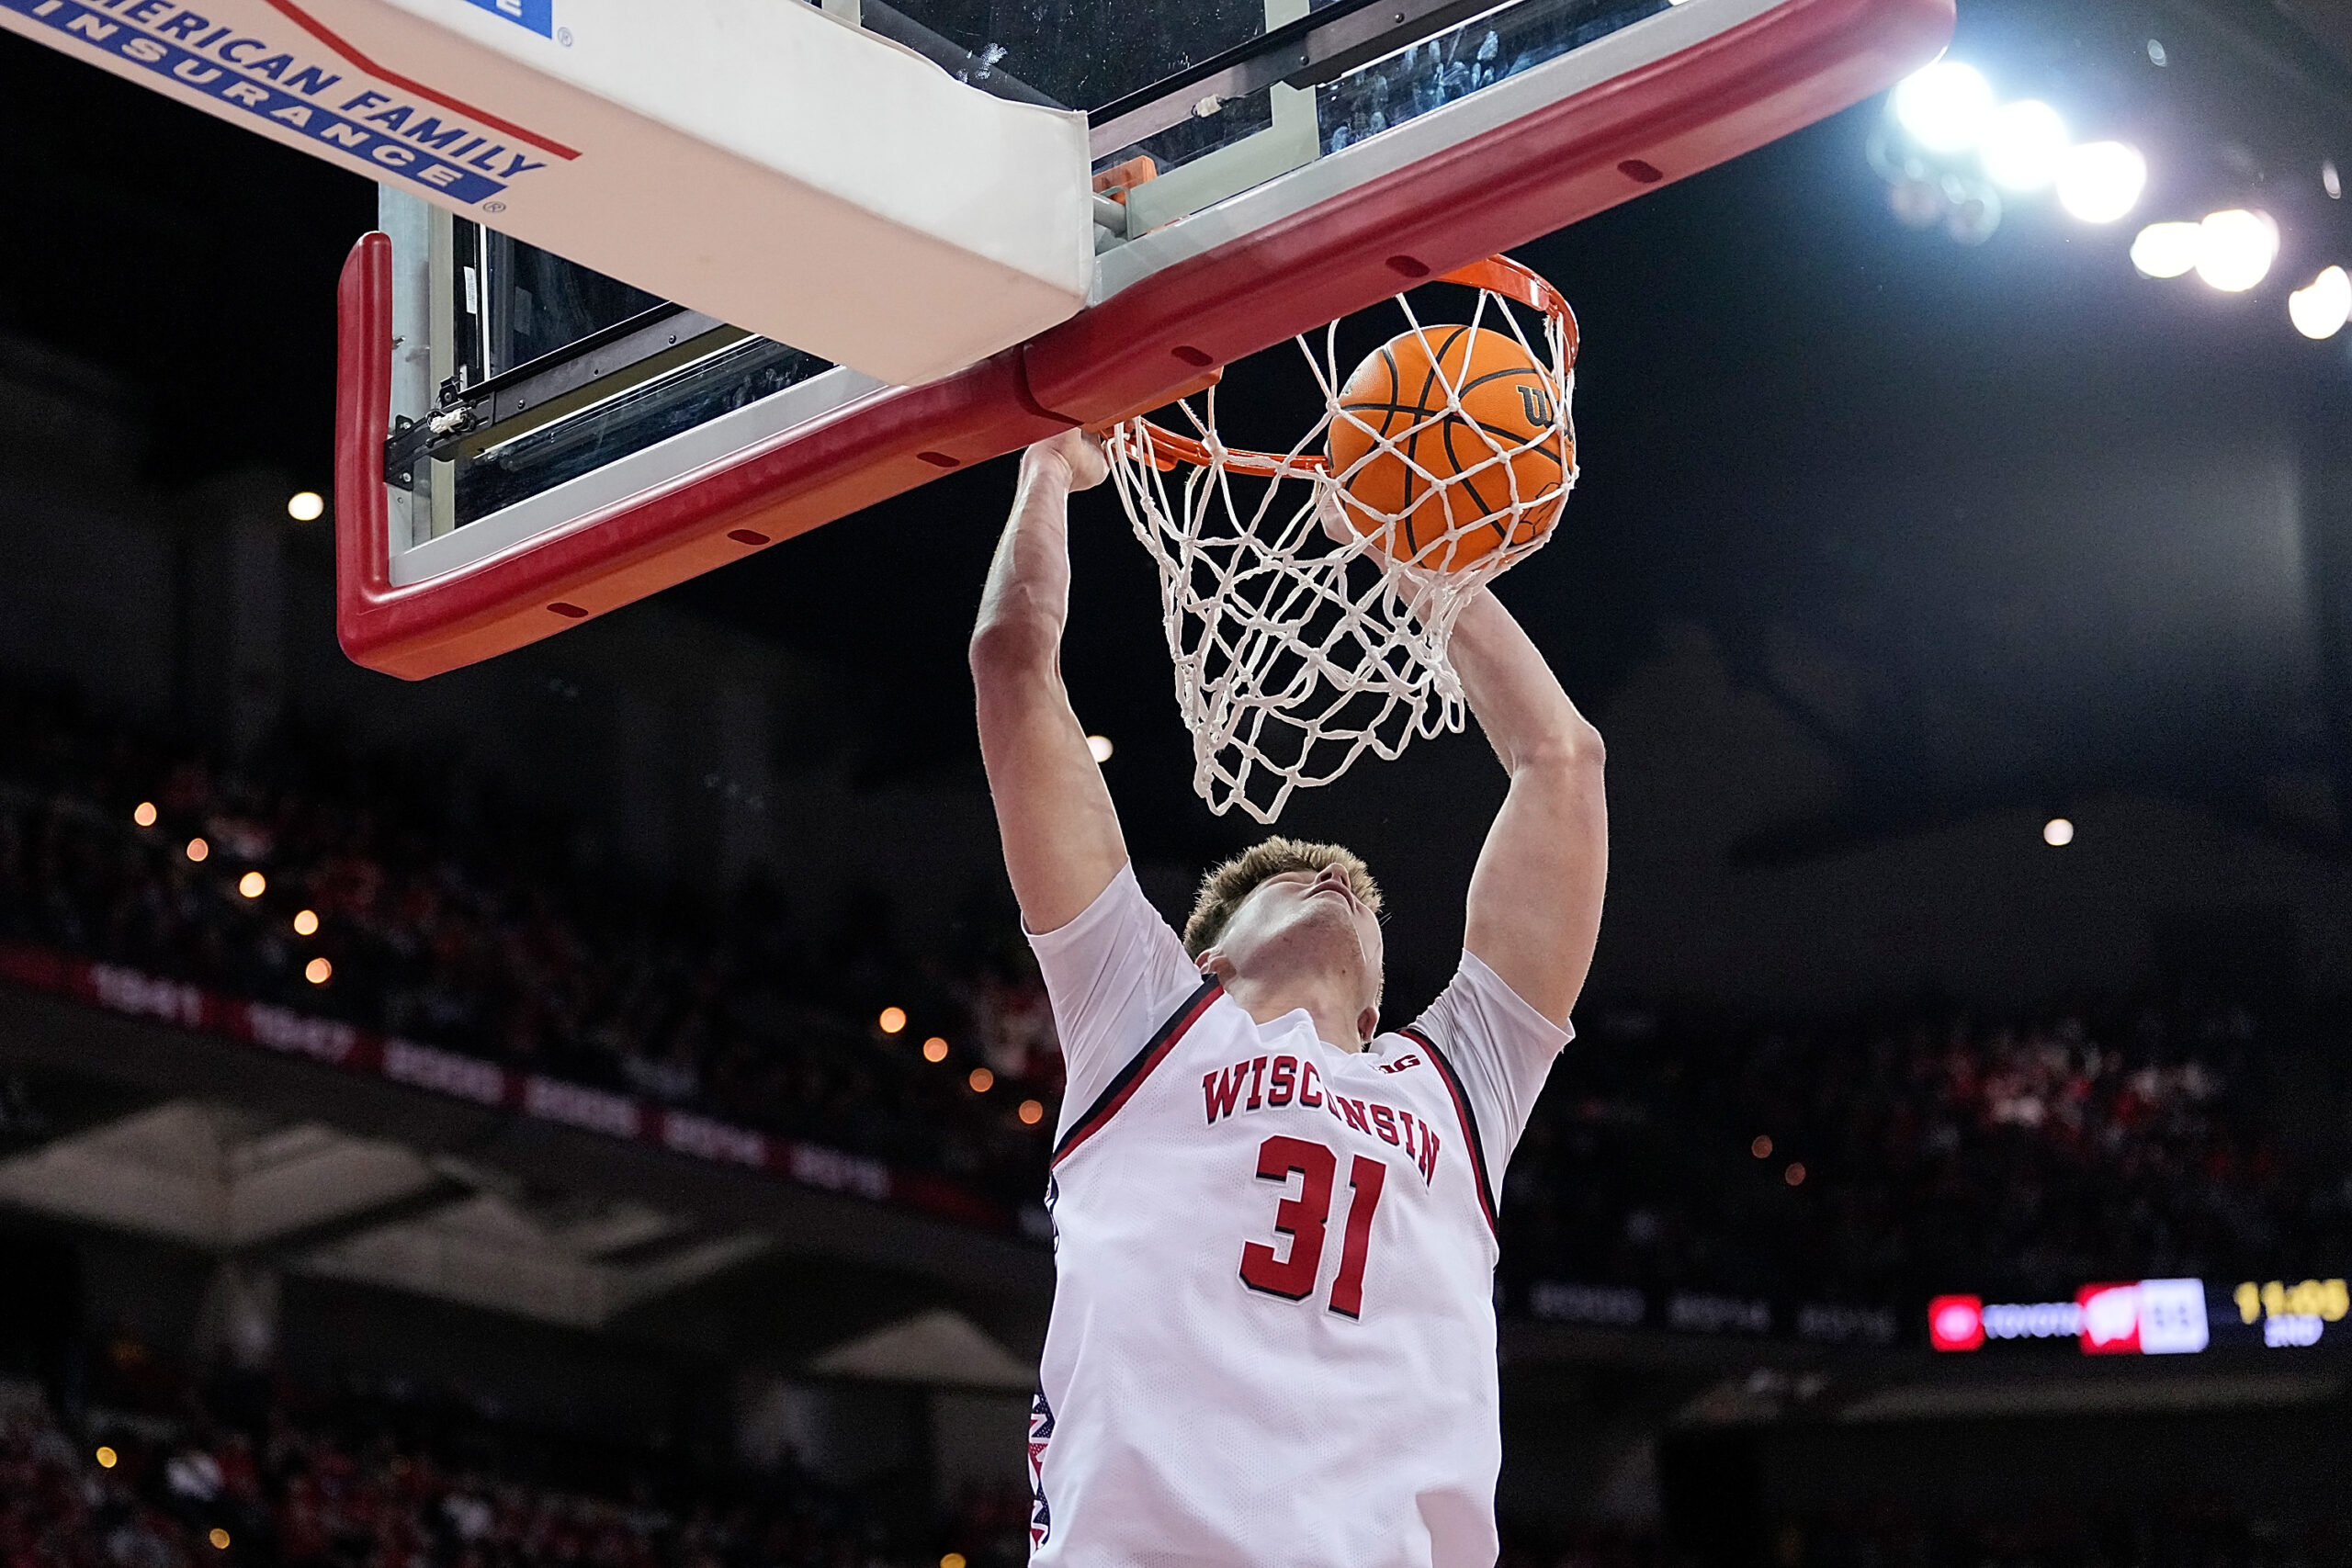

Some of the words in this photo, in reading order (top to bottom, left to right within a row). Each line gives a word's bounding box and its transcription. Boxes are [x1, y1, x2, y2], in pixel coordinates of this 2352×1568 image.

[32, 0, 463, 187] INSURANCE
[101, 0, 341, 95] ERICAN
[339, 90, 547, 178] FAMILY
[1238, 1134, 1387, 1320] 31
